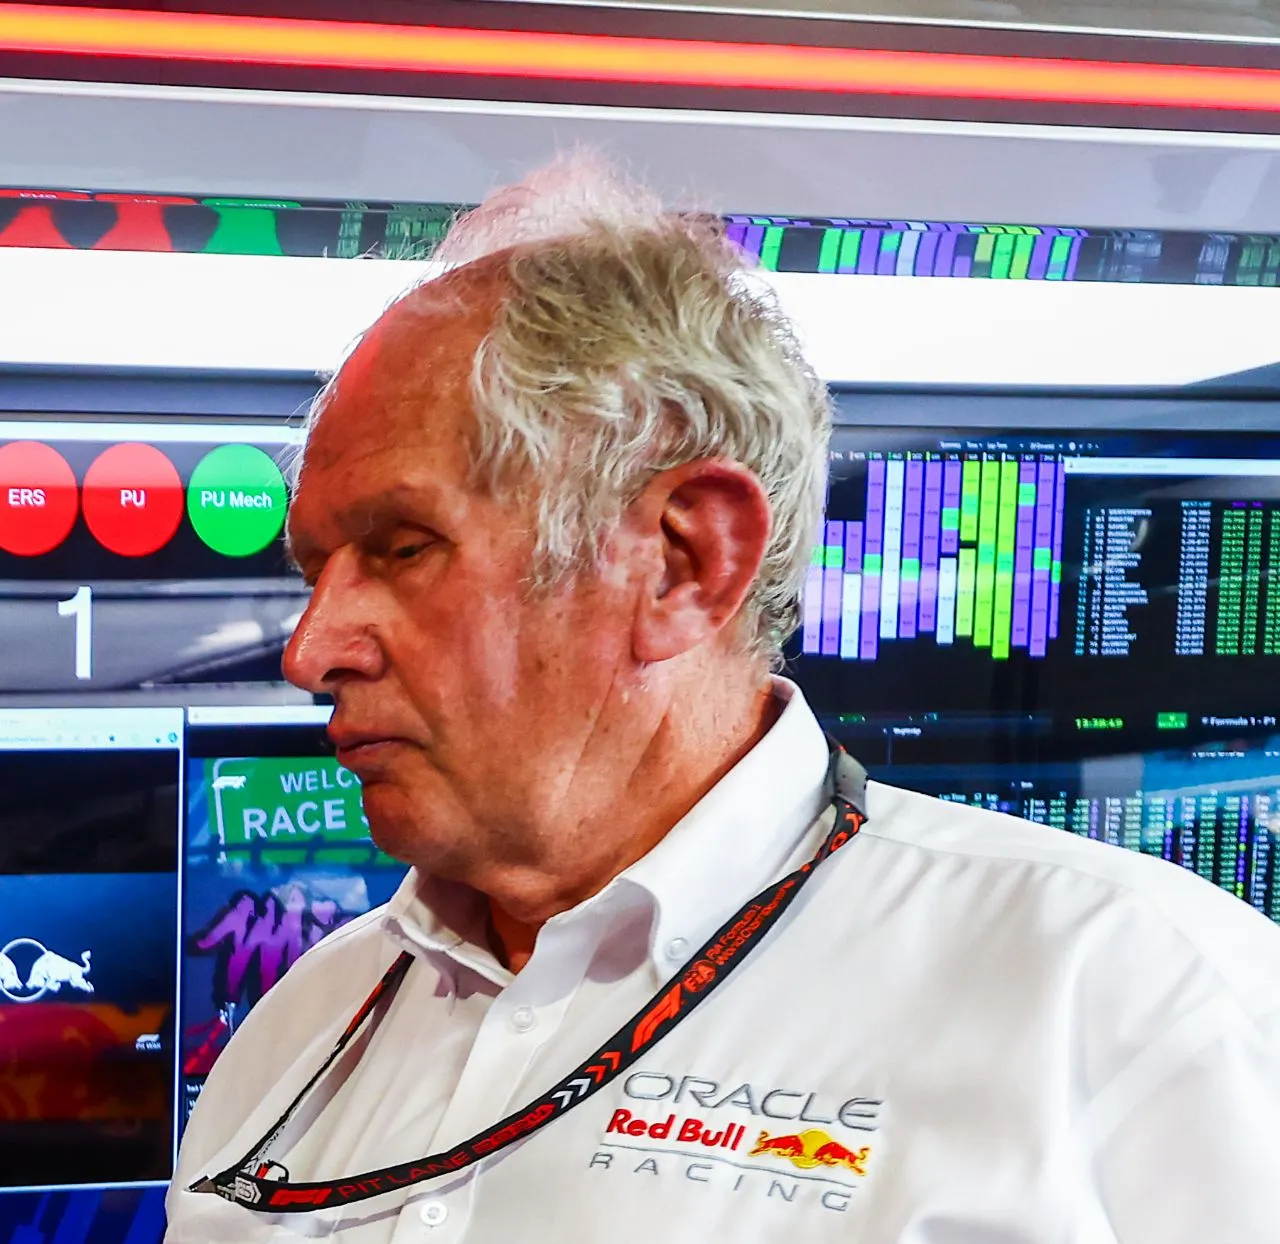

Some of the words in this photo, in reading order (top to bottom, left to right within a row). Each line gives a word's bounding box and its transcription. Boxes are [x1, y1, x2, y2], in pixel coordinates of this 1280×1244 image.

[8, 488, 45, 506] ERS
[120, 490, 145, 507] PU
[201, 491, 227, 507] PU
[230, 491, 272, 508] Mech
[58, 586, 92, 679] 1
[281, 768, 361, 795] WELC
[243, 799, 346, 840] RACE
[624, 1070, 883, 1132] ORACLE
[606, 1108, 679, 1141] Red
[685, 1116, 745, 1153] Bull
[339, 1174, 381, 1199] PIT
[389, 1151, 472, 1186] LANE
[590, 1152, 855, 1212] RACING
